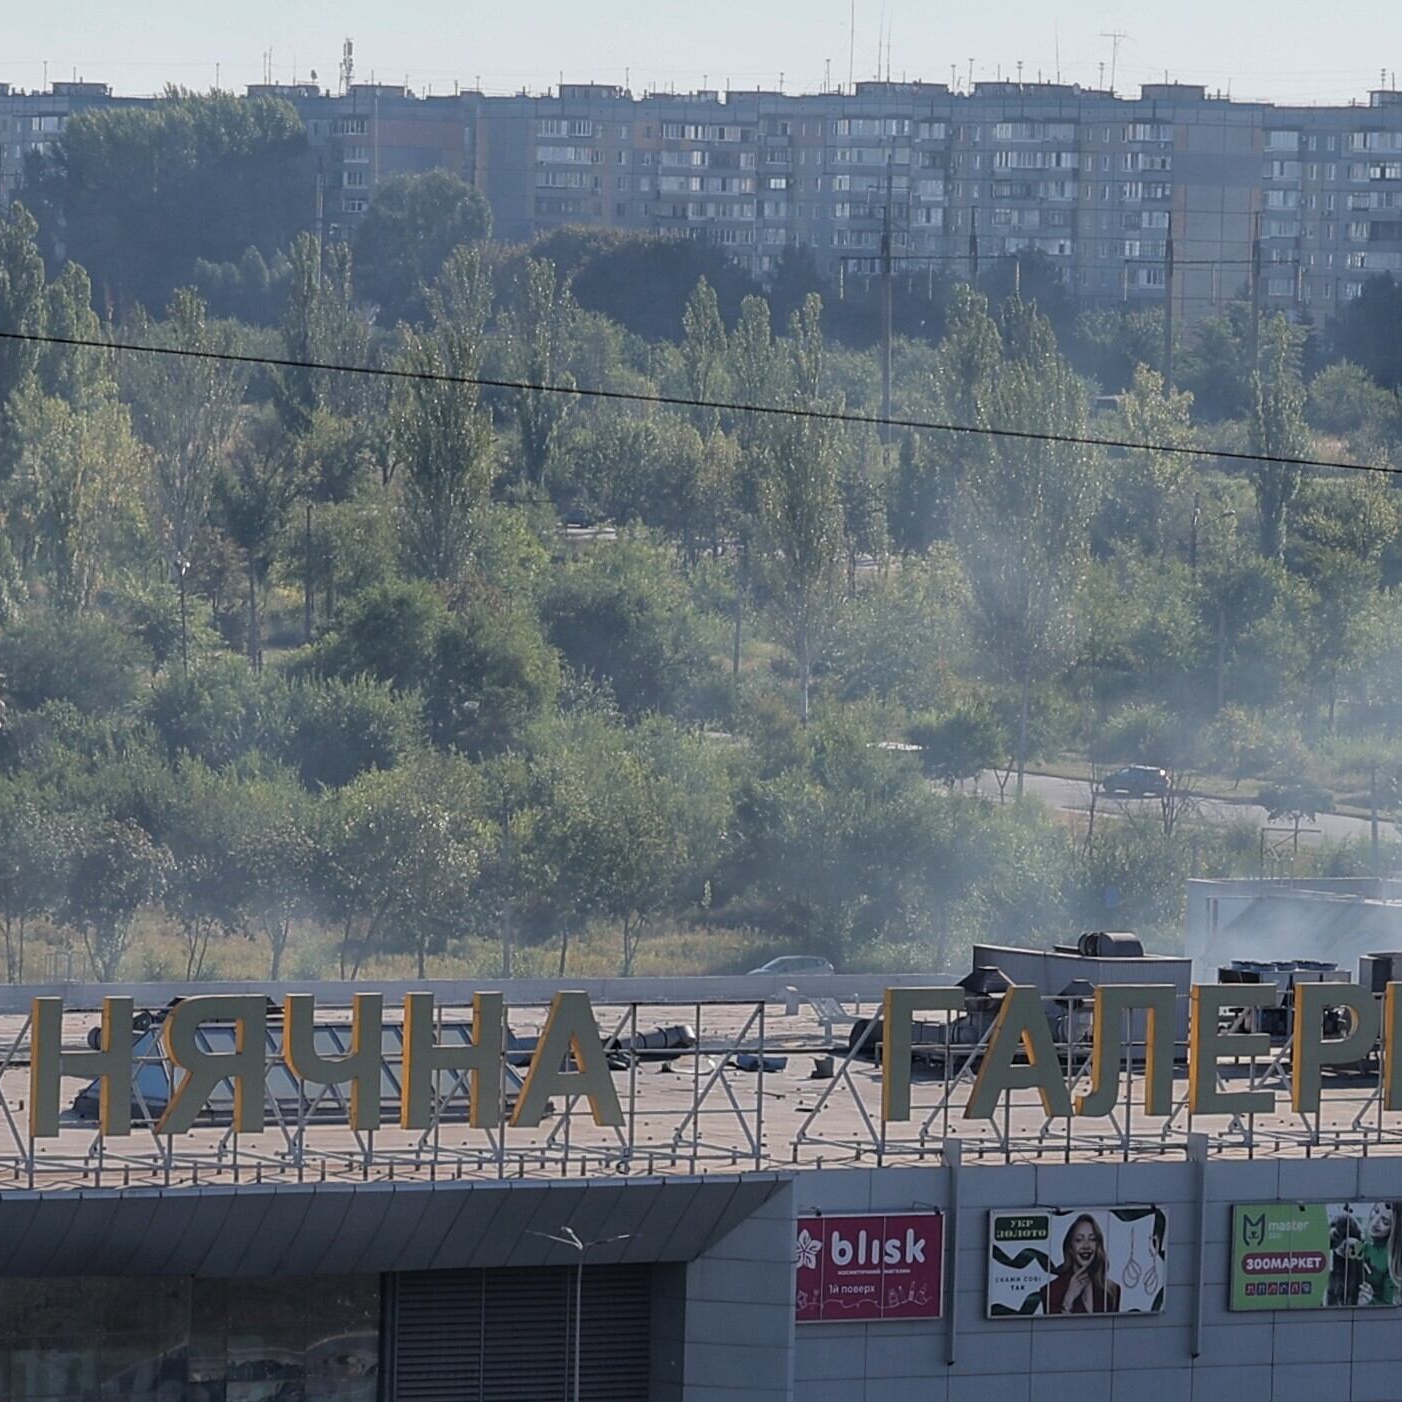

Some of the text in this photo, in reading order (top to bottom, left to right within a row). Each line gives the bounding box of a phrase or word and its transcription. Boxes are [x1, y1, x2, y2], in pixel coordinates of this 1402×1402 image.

[1010, 1219, 1034, 1228] УКР
[1268, 1220, 1310, 1232] master
[995, 1228, 1047, 1239] ЗОЛОТО
[831, 1227, 926, 1266] blisk
[1246, 1256, 1322, 1271] ЗООМАРКЕТ
[841, 1284, 875, 1296] поверх
[1010, 1284, 1025, 1292] ТАК
